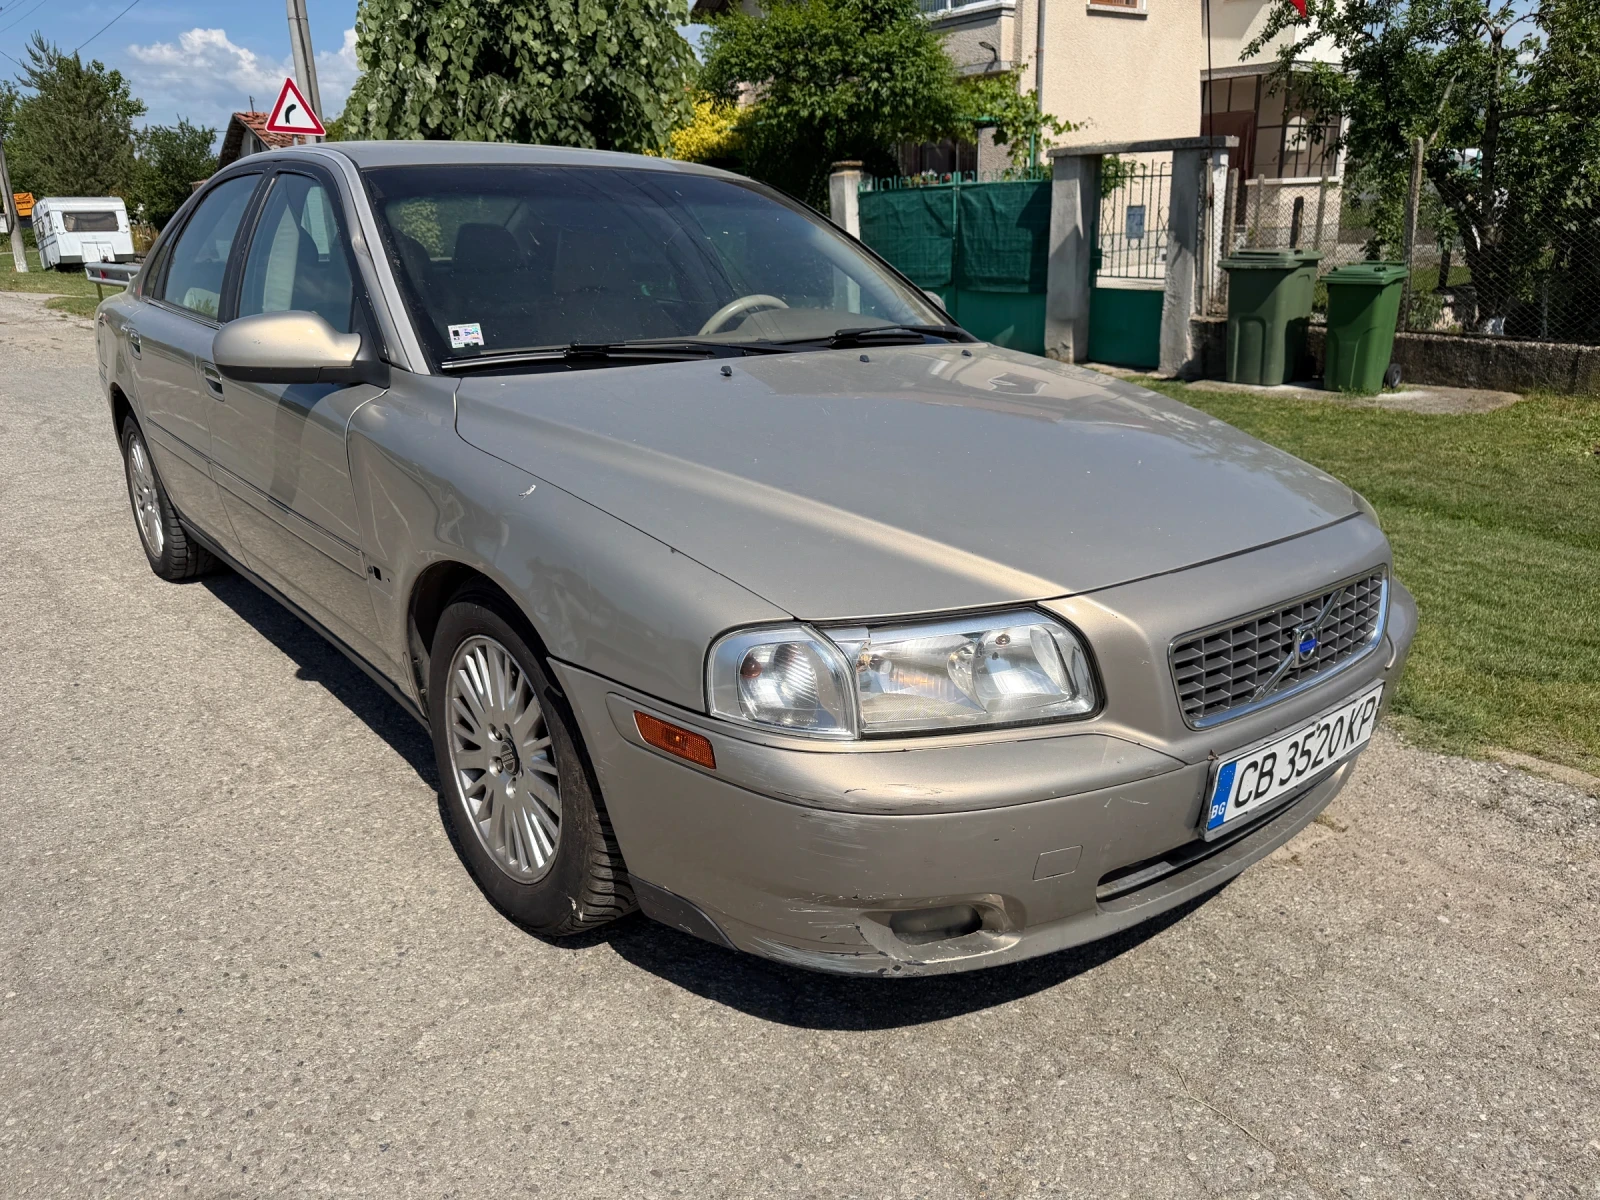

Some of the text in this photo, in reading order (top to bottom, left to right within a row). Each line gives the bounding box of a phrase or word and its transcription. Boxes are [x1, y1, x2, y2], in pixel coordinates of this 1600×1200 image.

[1234, 695, 1376, 808] CB 3520 KP
[1211, 802, 1226, 819] BG
